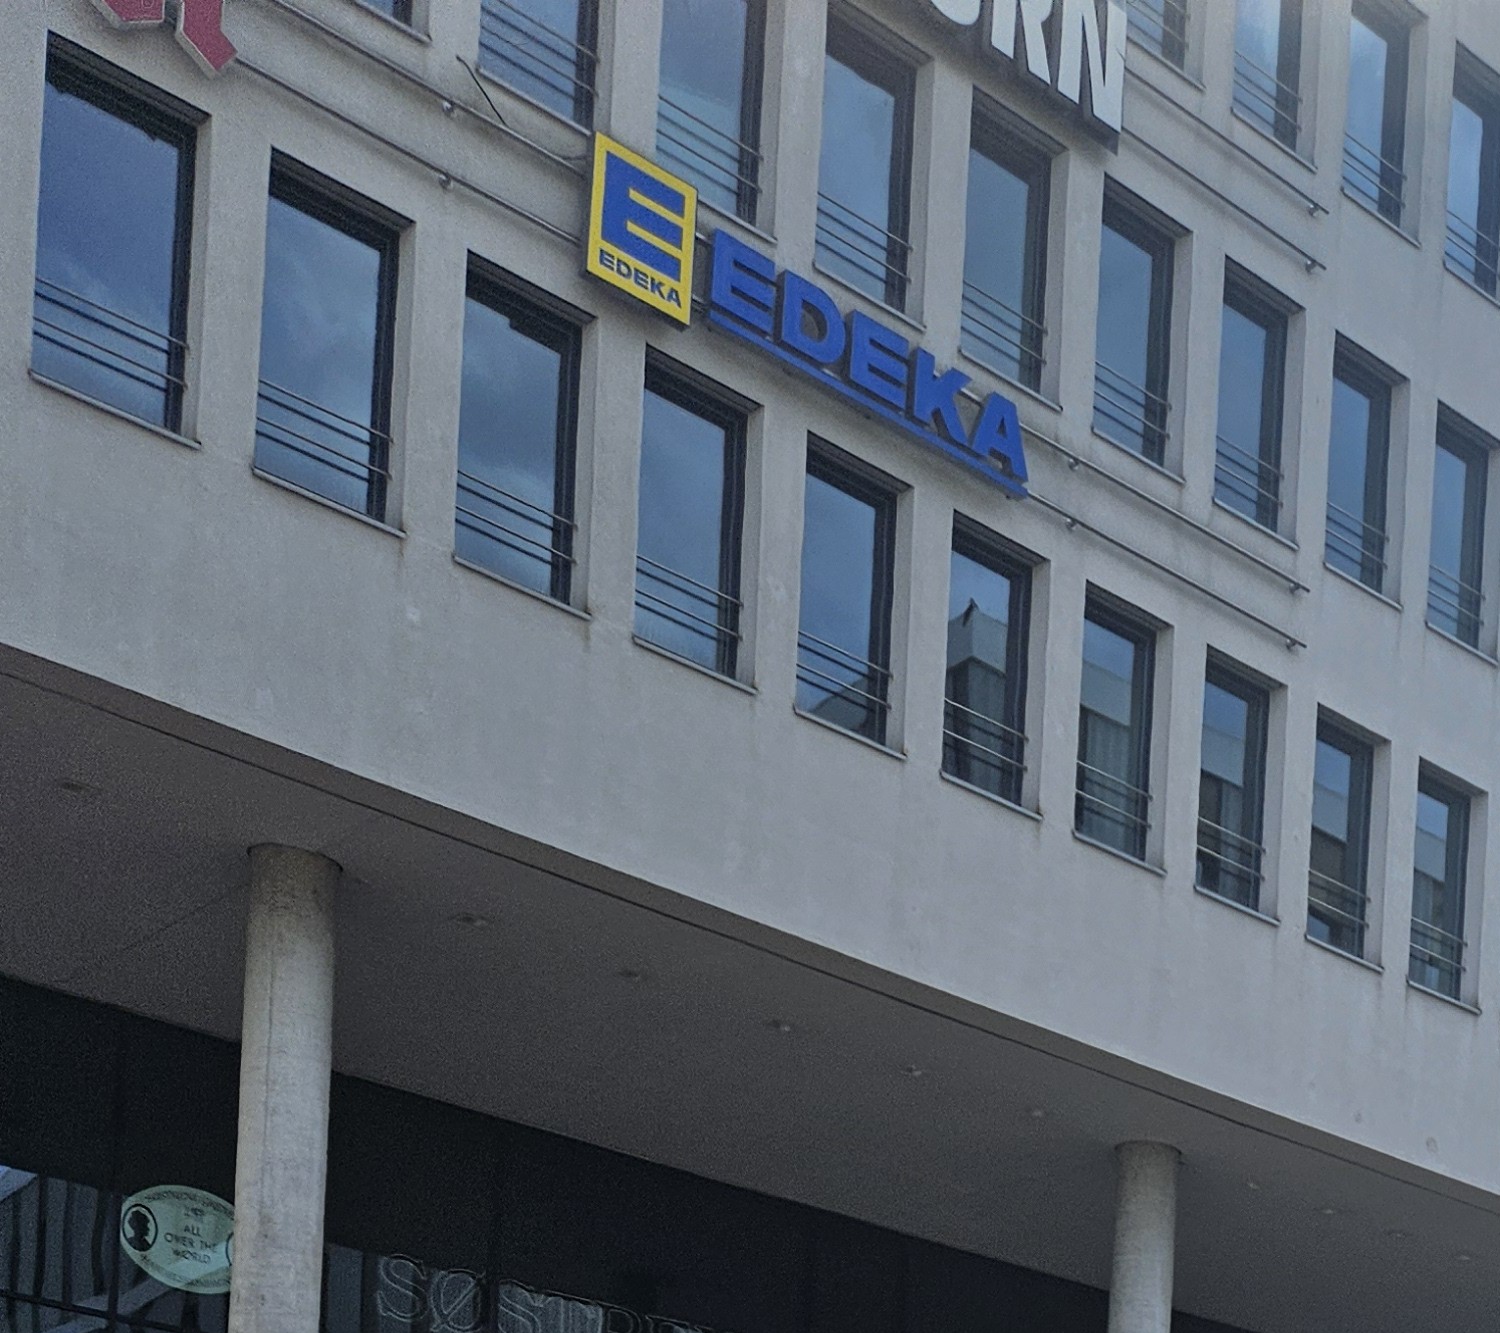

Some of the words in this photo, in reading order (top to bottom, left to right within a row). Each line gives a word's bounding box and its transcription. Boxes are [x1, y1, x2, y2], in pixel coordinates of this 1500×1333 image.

[931, 0, 1127, 134] RN
[599, 248, 682, 309] EDEKA
[709, 228, 1029, 482] EDEKA
